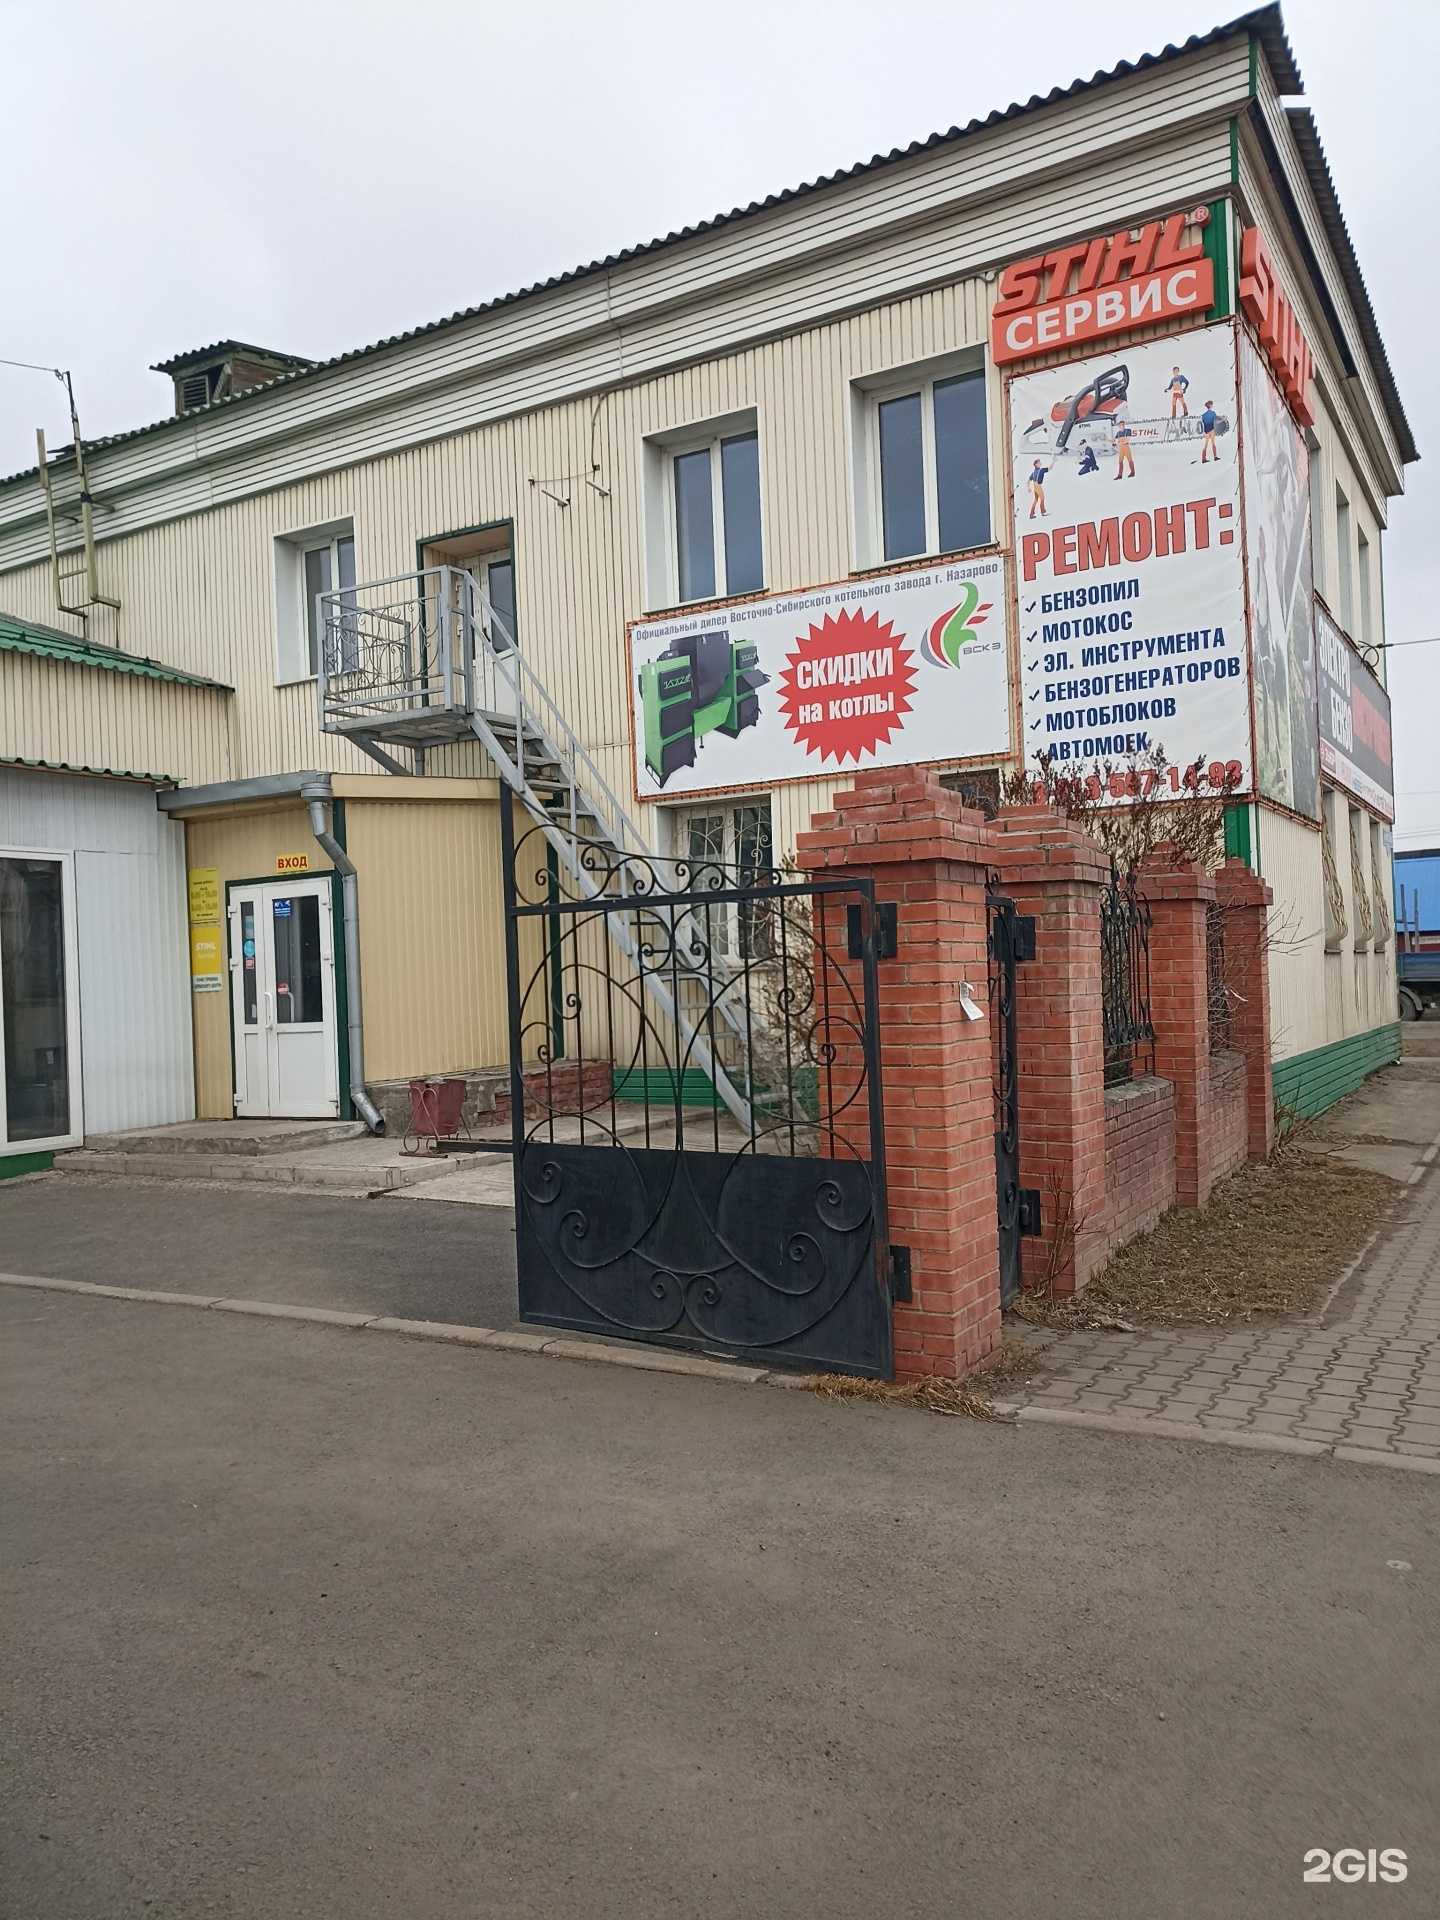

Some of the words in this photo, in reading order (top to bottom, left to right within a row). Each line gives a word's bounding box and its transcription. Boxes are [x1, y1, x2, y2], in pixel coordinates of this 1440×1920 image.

[992, 214, 1205, 318] STIHL
[1006, 269, 1198, 351] СЕРВИС
[1131, 428, 1159, 437] STIHL
[1022, 497, 1234, 582] РЕМОНТ:
[636, 620, 698, 642] Официальный
[700, 614, 727, 629] дилер
[730, 597, 831, 623] Восточно-Сибирского
[834, 584, 891, 602] котельного
[894, 578, 931, 592] завода
[935, 574, 943, 584] г.
[946, 563, 998, 582] Назарово
[1041, 579, 1140, 614] БЕНЗОПИЛ
[1042, 611, 1133, 644] МОТОКОС
[796, 647, 894, 690] СКИДКИ
[1043, 651, 1074, 673] ЭЛ.
[1081, 627, 1226, 668] ИНСТРУМЕНТА
[1045, 656, 1241, 703] БЕНЗОГЕНЕРАТОРОВ
[799, 702, 823, 724] на
[828, 691, 895, 720] котлы
[1046, 697, 1177, 733] МОТОБЛОКОВ
[1048, 731, 1148, 762] АВТОМОЕК
[277, 856, 308, 869] ВХОД
